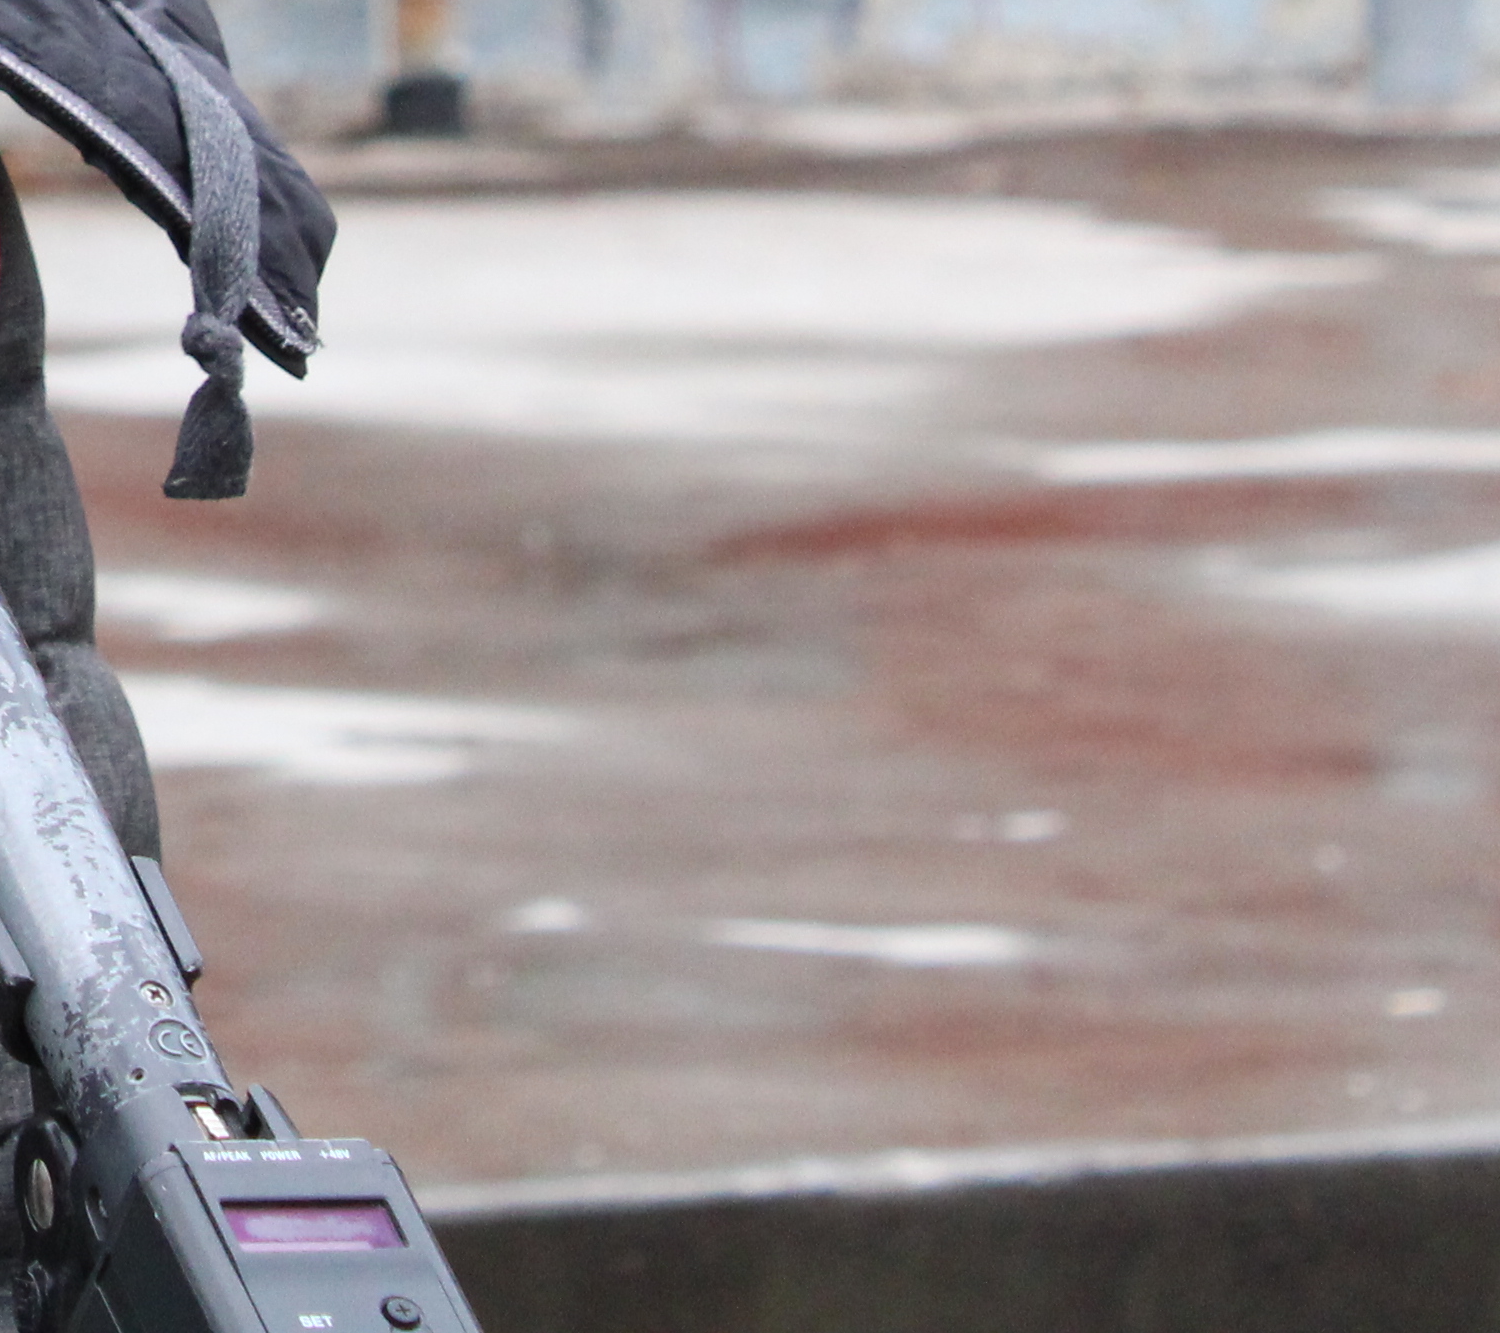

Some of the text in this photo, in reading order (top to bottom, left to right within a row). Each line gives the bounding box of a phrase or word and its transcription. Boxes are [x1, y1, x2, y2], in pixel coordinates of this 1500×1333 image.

[157, 1029, 203, 1059] CE
[260, 1150, 302, 1162] POWER
[298, 1314, 334, 1329] SET
